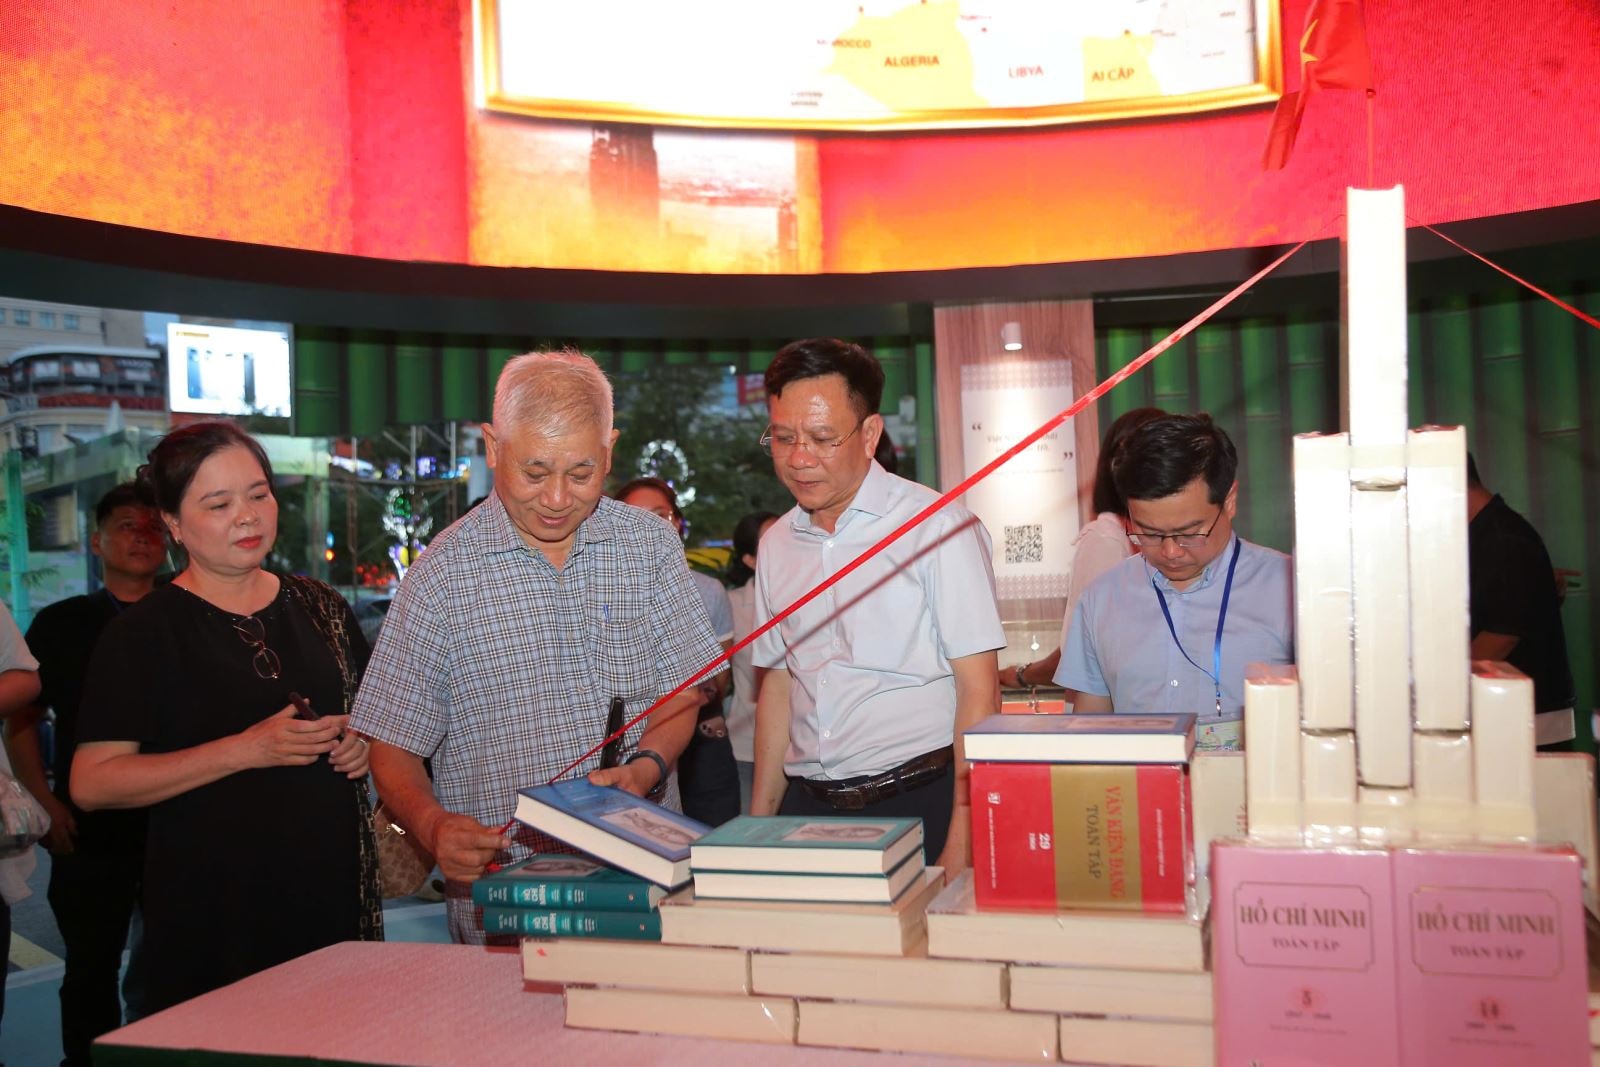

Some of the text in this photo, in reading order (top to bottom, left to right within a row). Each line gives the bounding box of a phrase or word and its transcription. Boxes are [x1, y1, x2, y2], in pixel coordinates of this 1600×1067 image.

[884, 55, 940, 67] ALGERIA
[1008, 65, 1044, 79] LIBYA
[1092, 71, 1104, 82] AI
[1273, 903, 1308, 926] CHÍ
[1313, 907, 1366, 928] MINH
[1452, 907, 1490, 933] CHÍ
[1497, 913, 1554, 935] MINH
